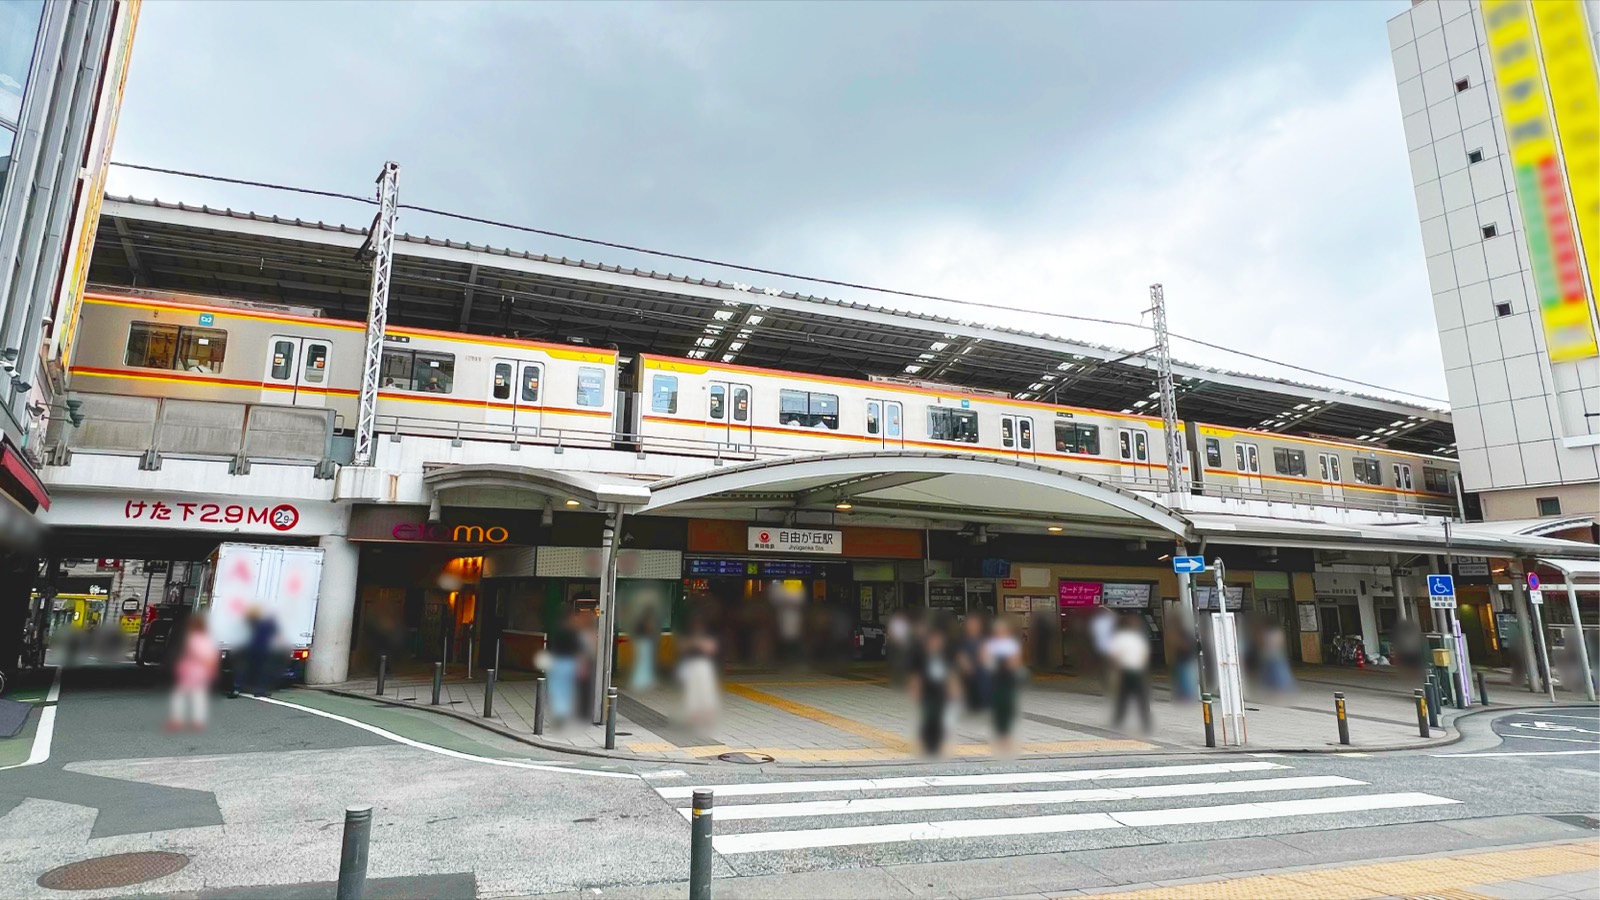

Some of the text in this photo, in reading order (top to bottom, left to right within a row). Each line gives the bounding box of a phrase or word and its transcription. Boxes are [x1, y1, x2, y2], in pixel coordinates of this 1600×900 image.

[779, 531, 833, 545] 自由が丘駅
